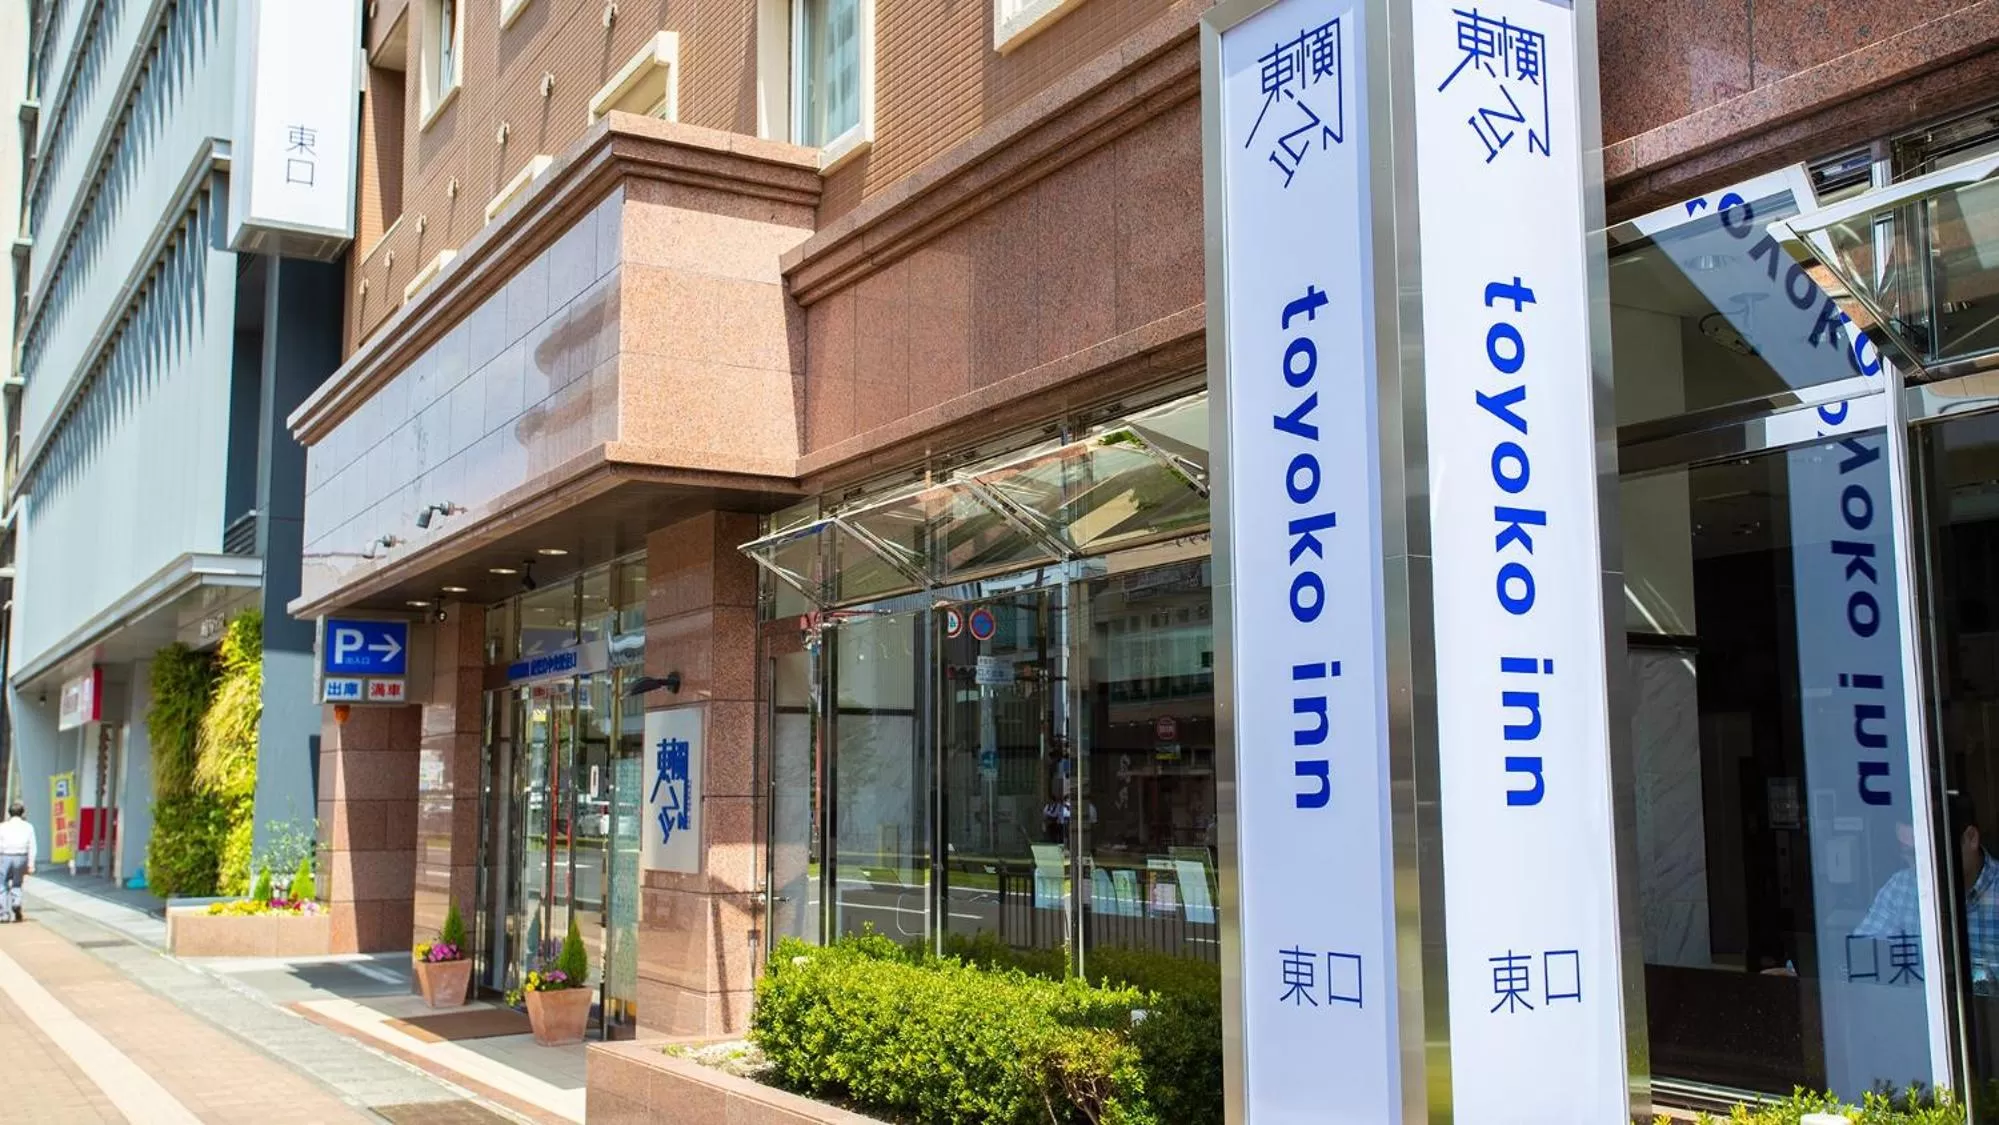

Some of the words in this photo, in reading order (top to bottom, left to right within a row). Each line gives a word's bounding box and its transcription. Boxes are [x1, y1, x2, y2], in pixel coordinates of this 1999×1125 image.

[285, 123, 319, 188] 東口
[1273, 284, 1337, 623] toyoko
[1475, 276, 1547, 615] toyoko
[334, 628, 364, 664] P
[327, 681, 358, 696] 出庫
[1292, 660, 1342, 809] inn
[1500, 656, 1554, 807] inn
[1278, 944, 1364, 1009] 東口
[1489, 948, 1582, 1014] 東口
